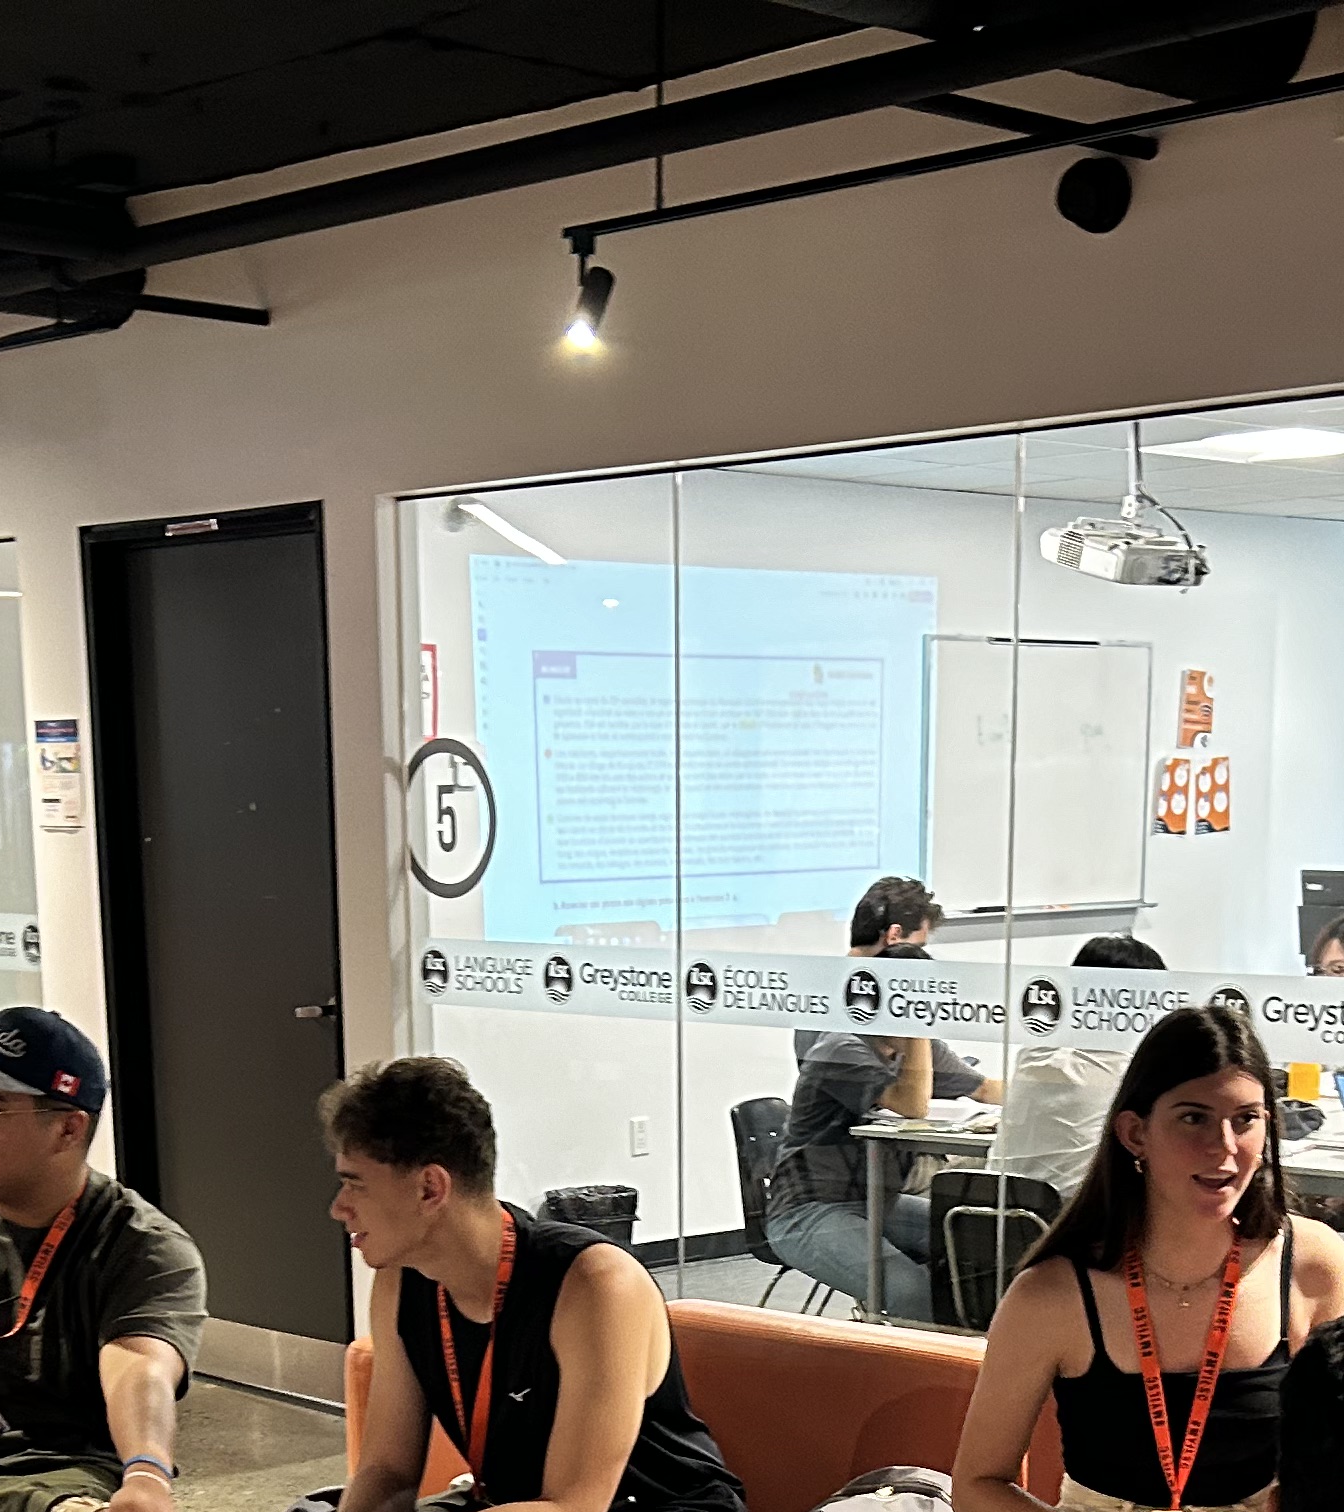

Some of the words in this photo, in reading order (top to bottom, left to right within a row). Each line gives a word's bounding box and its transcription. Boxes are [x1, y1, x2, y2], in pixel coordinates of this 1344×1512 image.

[437, 785, 456, 852] 5
[454, 955, 533, 976] LANGUAGE
[579, 962, 673, 991] Greystone
[723, 965, 789, 990] ÉCOLES
[455, 974, 524, 994] SCHOOLS
[888, 977, 958, 994] COLLÈGE
[723, 990, 744, 1009] DE
[745, 993, 829, 1015] LANGUES
[888, 994, 1005, 1026] Greystone
[1071, 987, 1189, 1011] LANGUAGE
